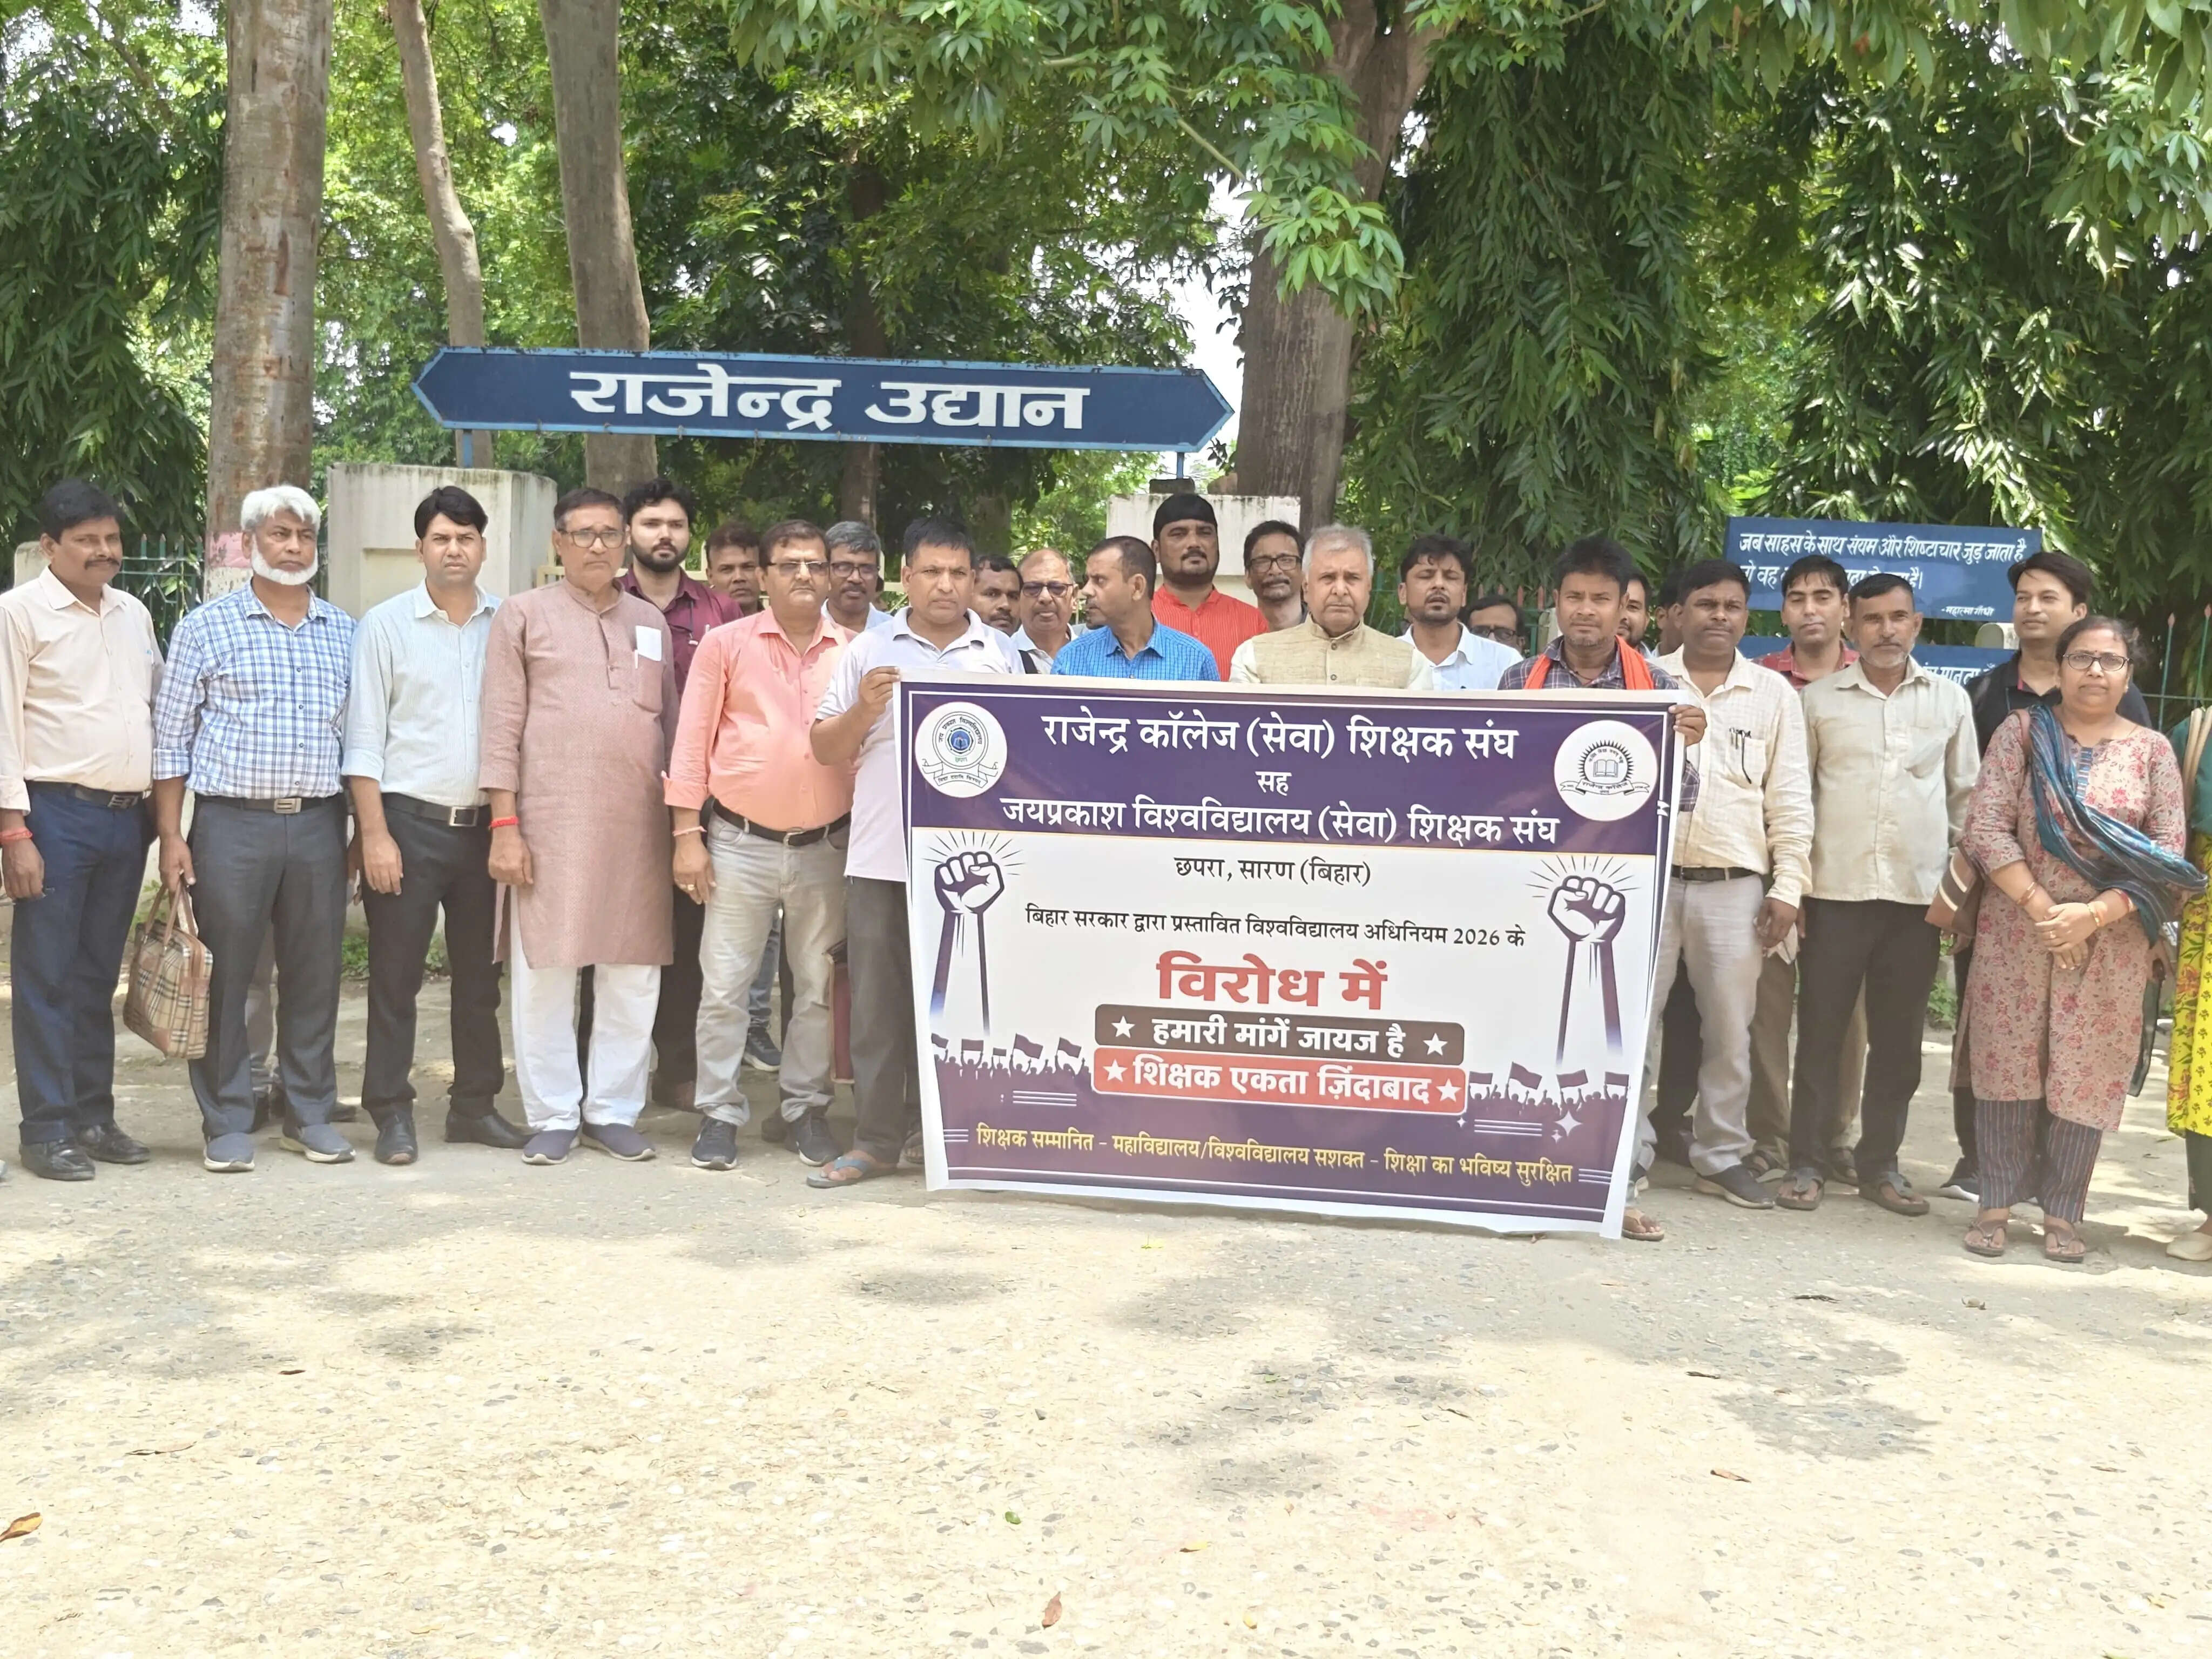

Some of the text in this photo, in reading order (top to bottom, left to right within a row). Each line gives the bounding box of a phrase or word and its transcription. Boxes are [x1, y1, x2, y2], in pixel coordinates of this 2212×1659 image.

[570, 363, 1090, 430] राजेन्द्र उद्यान
[1739, 530, 2027, 564] जब साहस के साथ संयम और शिष्टाचार जुड़ जाता है
[1758, 567, 1780, 589] वह
[1041, 706, 1519, 763] राजेन्द्र कॉलेज (सेवा) शिक्षक संघ
[1256, 772, 1292, 795] सह
[1000, 794, 1560, 847] जयप्रकाश विश्वविद्यालय (सेवा) शिक्षक संघ
[1238, 860, 1295, 880] सारण
[1300, 857, 1370, 887] (बिहार)
[1026, 903, 1525, 946] बिहार सरकार द्वारा प्रस्तावित विश्वविद्यालय अधिनियम 2026 के
[1157, 950, 1387, 1010] विरोध में
[1152, 1014, 1406, 1058] हमारी मांगें जायज है
[1133, 1053, 1222, 1089] शिक्षक
[1230, 1068, 1309, 1094] एकता
[976, 1122, 1027, 1149] शिक्षक
[1031, 1127, 1094, 1150] सम्मानित
[1313, 1149, 1365, 1168] सशक्त
[1384, 1148, 1427, 1175] शिक्षा
[1431, 1157, 1454, 1174] का
[1460, 1153, 1512, 1177] भविष्य
[1515, 1157, 1573, 1186] सुरक्षित
